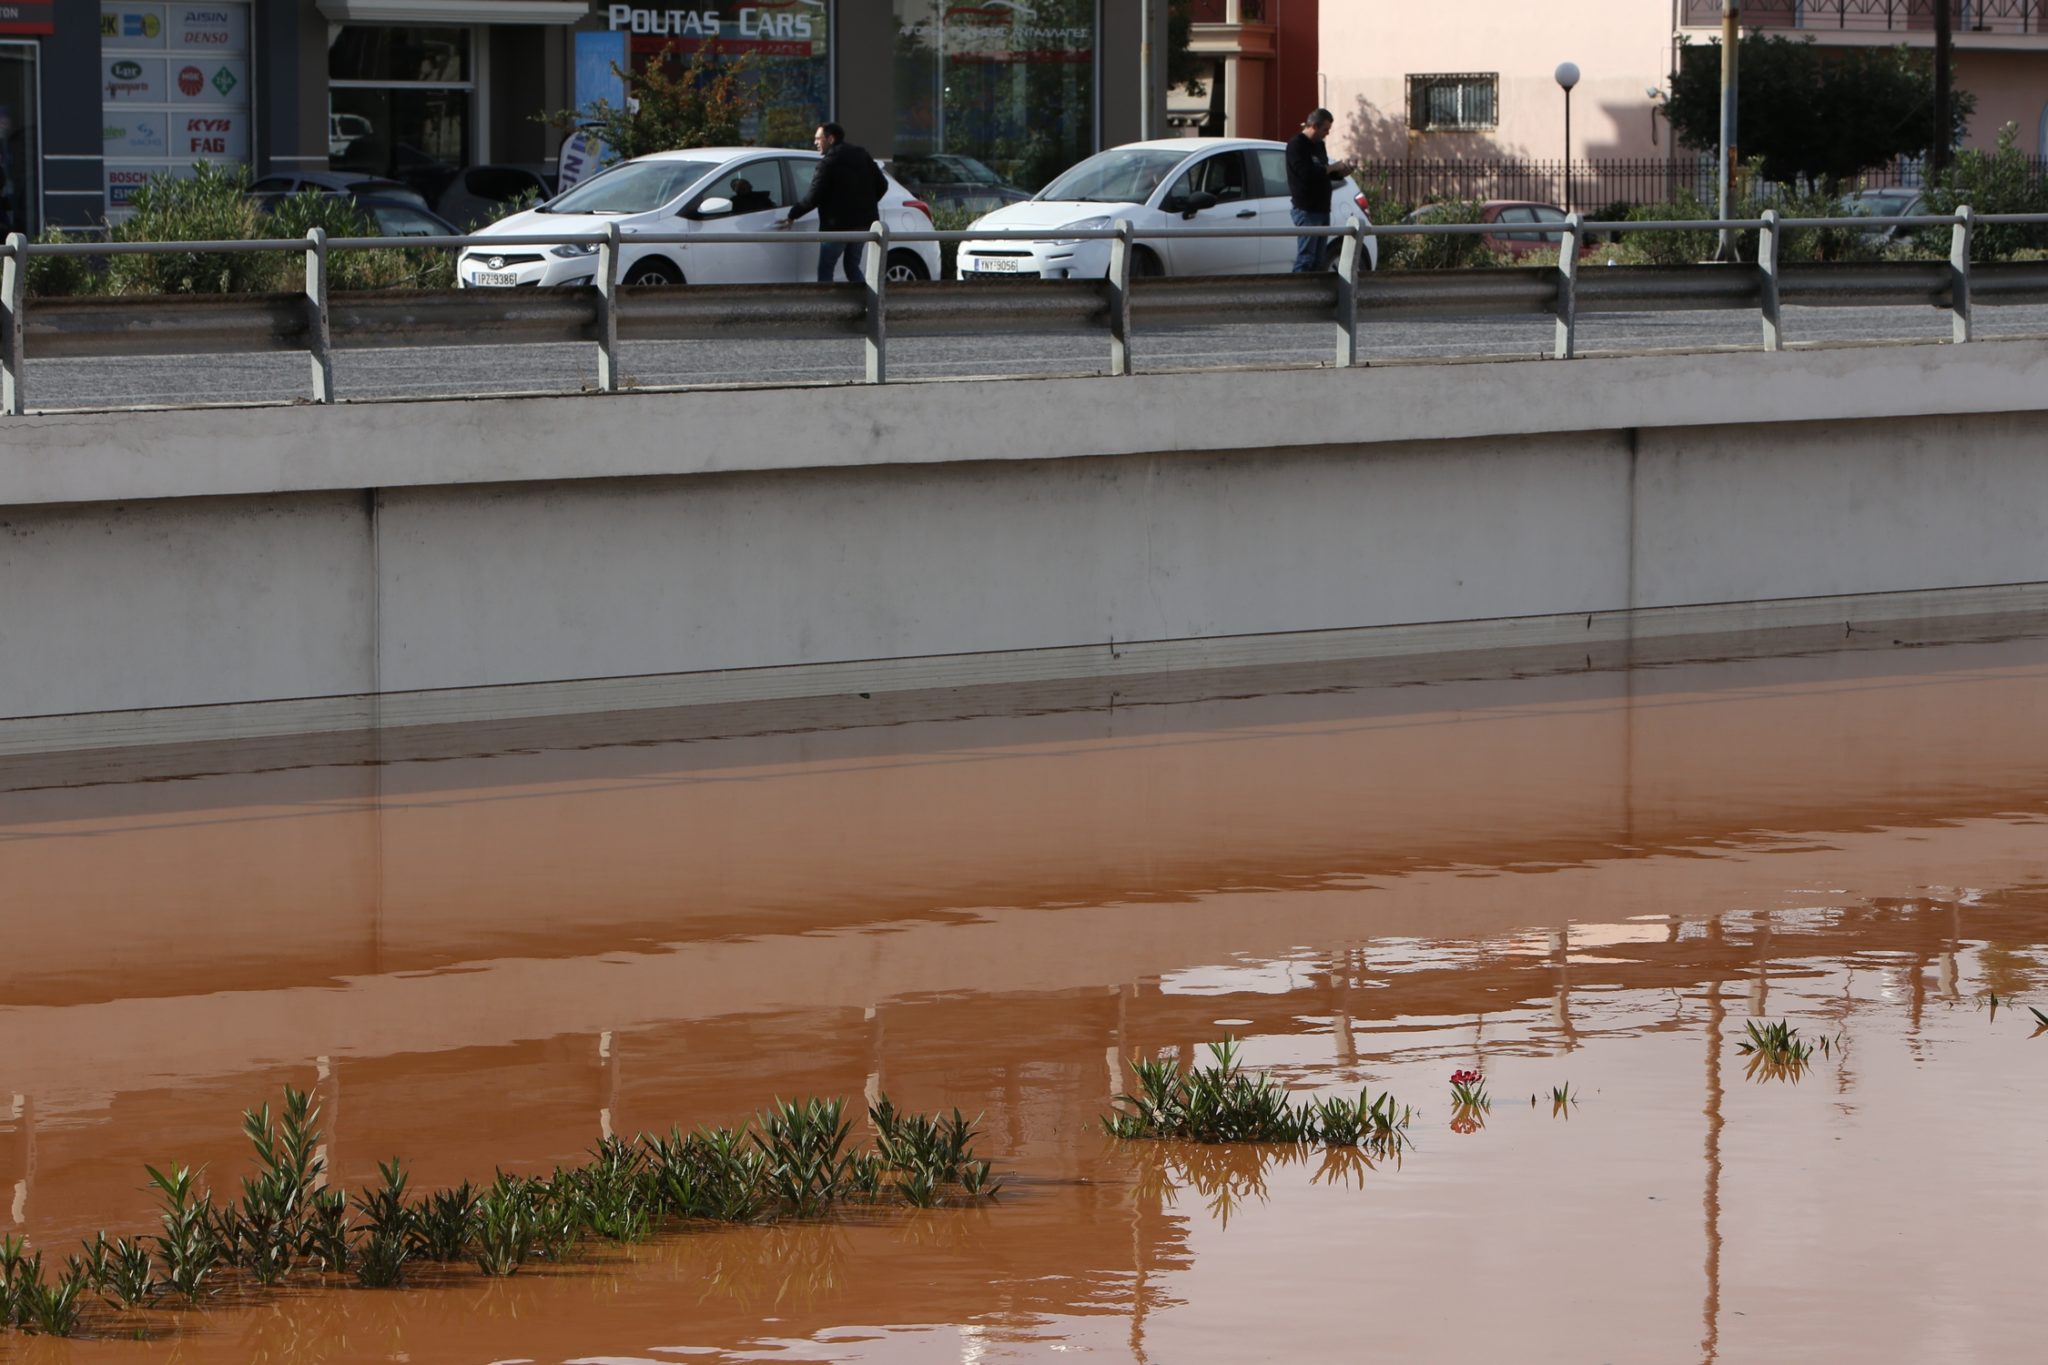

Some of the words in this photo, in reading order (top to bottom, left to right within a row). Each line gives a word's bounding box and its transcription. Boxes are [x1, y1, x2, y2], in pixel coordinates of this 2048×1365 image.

[185, 12, 228, 23] AISIN
[739, 8, 812, 37] CARS
[184, 32, 228, 44] DENSO
[190, 138, 225, 153] FAG
[109, 172, 147, 183] BOSCH
